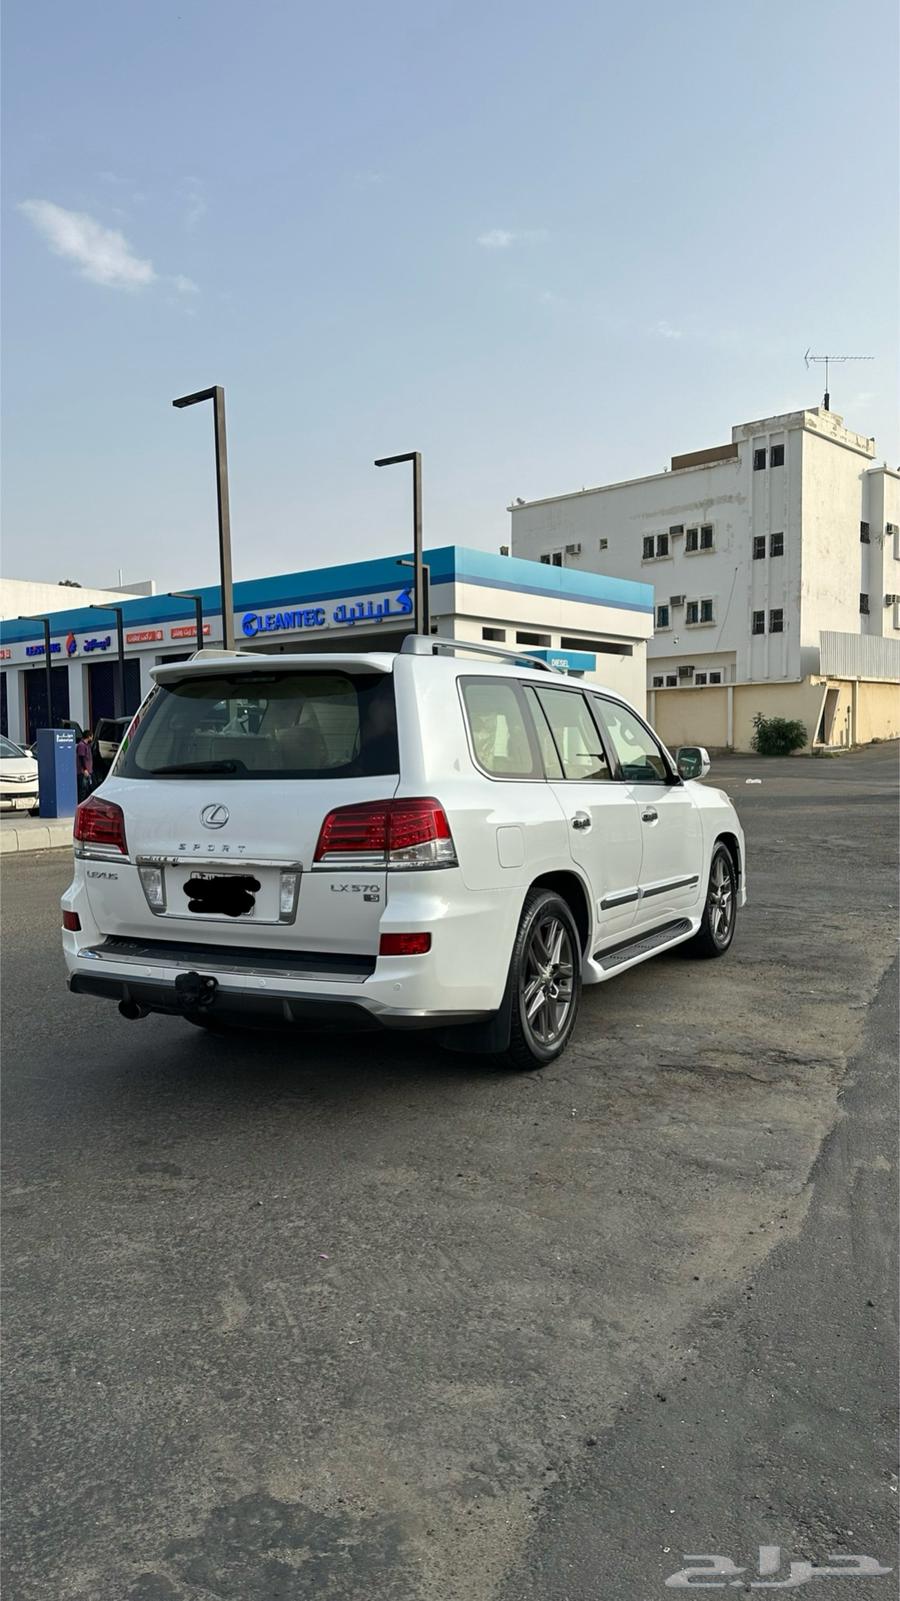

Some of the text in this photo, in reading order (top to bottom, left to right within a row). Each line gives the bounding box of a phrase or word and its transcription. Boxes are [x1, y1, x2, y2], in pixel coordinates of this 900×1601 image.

[333, 587, 413, 625] كلينتيك
[241, 608, 326, 637] CLEANTEC
[551, 658, 569, 668] DIESEL
[178, 843, 246, 853] SPORT
[86, 870, 119, 880] LEXUS
